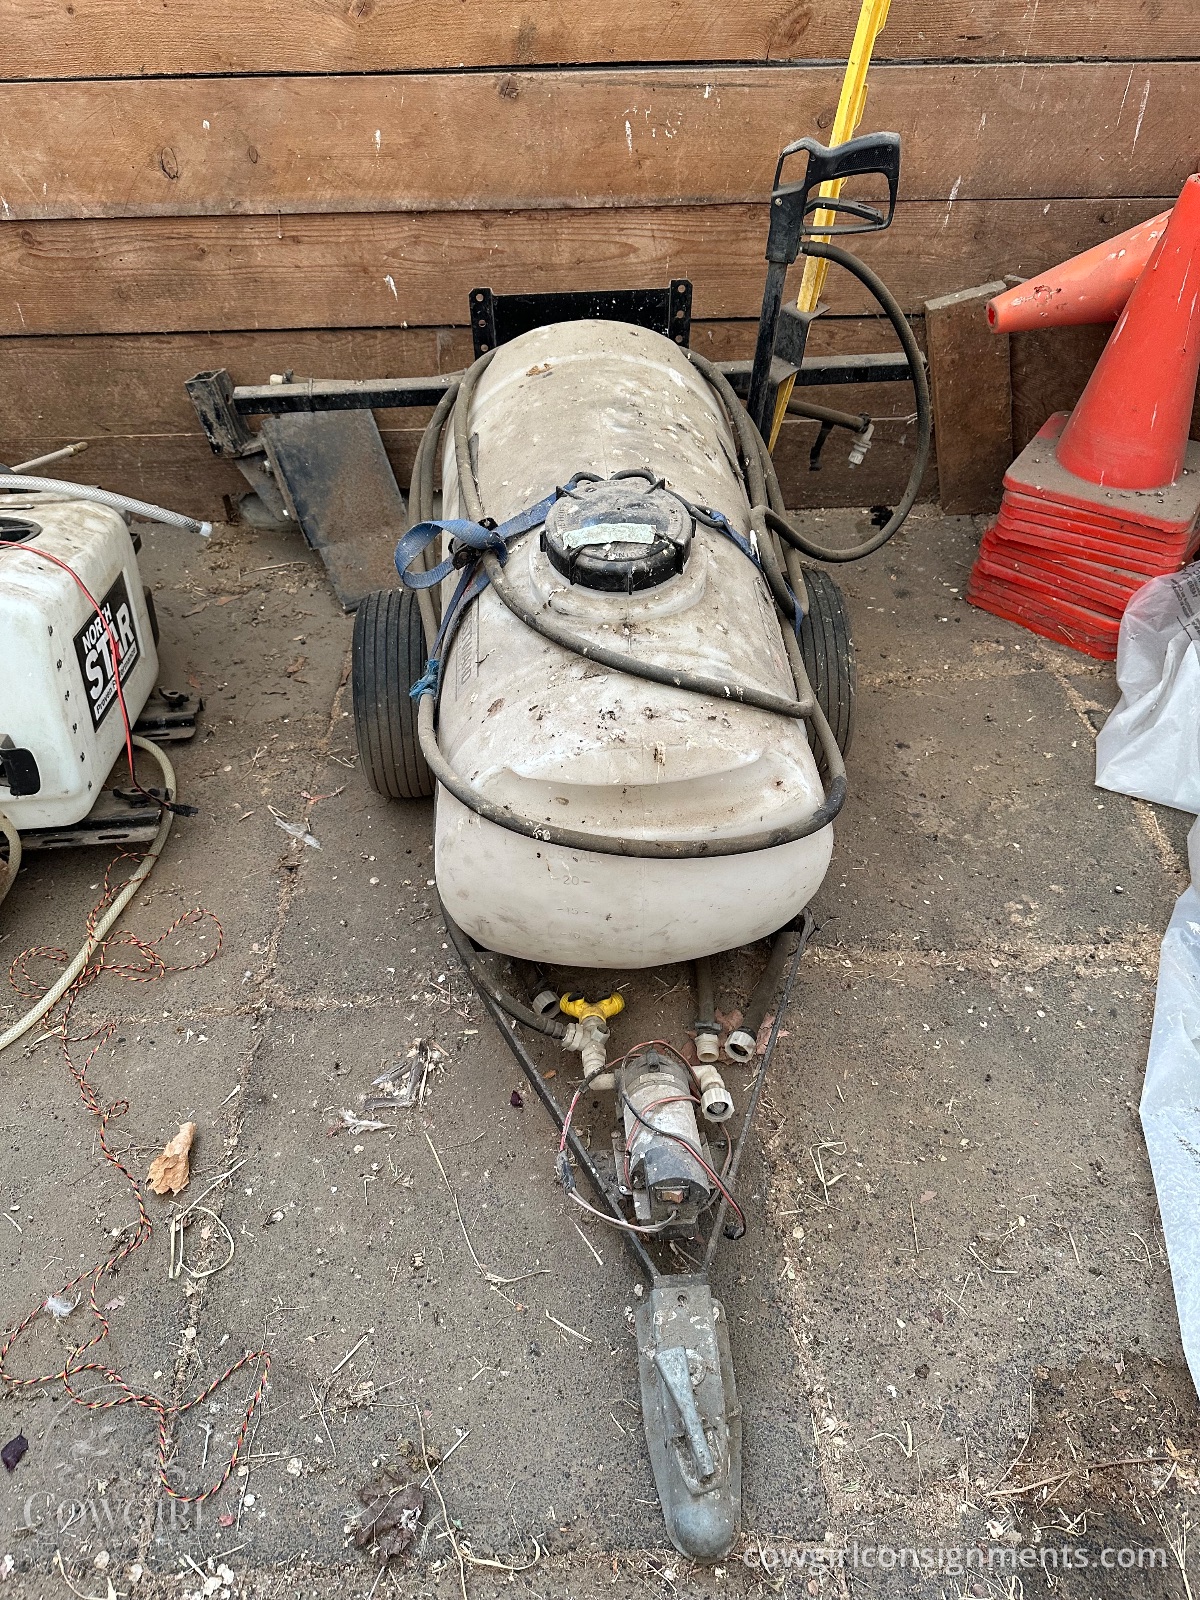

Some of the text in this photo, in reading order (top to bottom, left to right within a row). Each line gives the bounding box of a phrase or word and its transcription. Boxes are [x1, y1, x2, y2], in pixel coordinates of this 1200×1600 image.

[85, 603, 135, 700] STAR
[96, 687, 113, 715] Proven
[562, 874, 580, 886] 20
